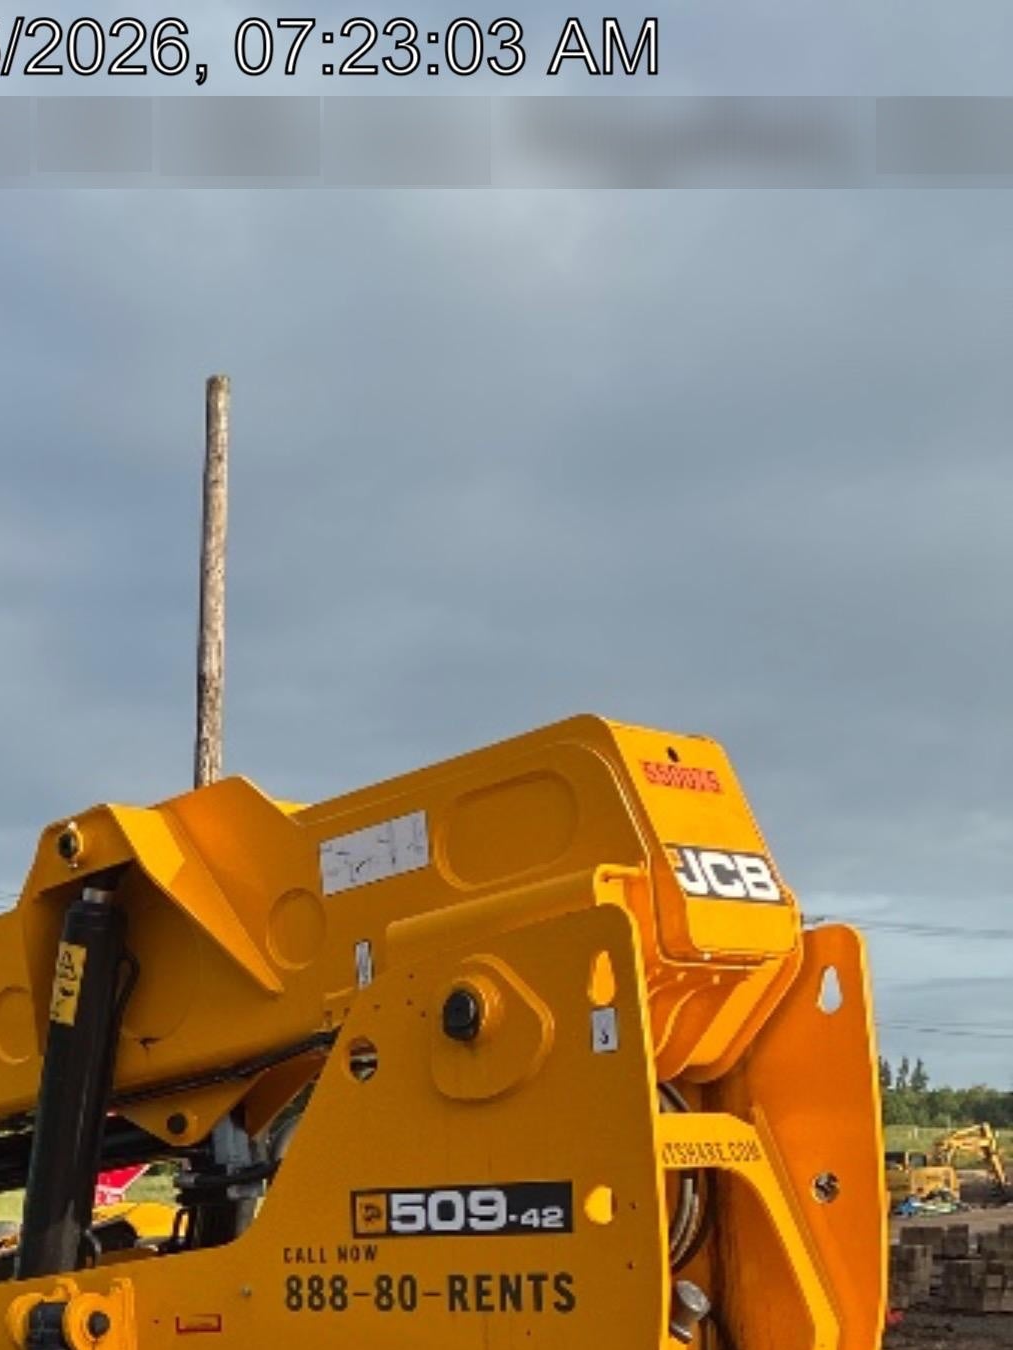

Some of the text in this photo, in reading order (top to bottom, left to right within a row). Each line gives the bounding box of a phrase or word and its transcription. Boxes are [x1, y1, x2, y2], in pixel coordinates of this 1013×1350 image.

[676, 847, 781, 901] JCB
[283, 1244, 378, 1265] CALL NOW
[284, 1271, 576, 1313] 888-80-RENTS
